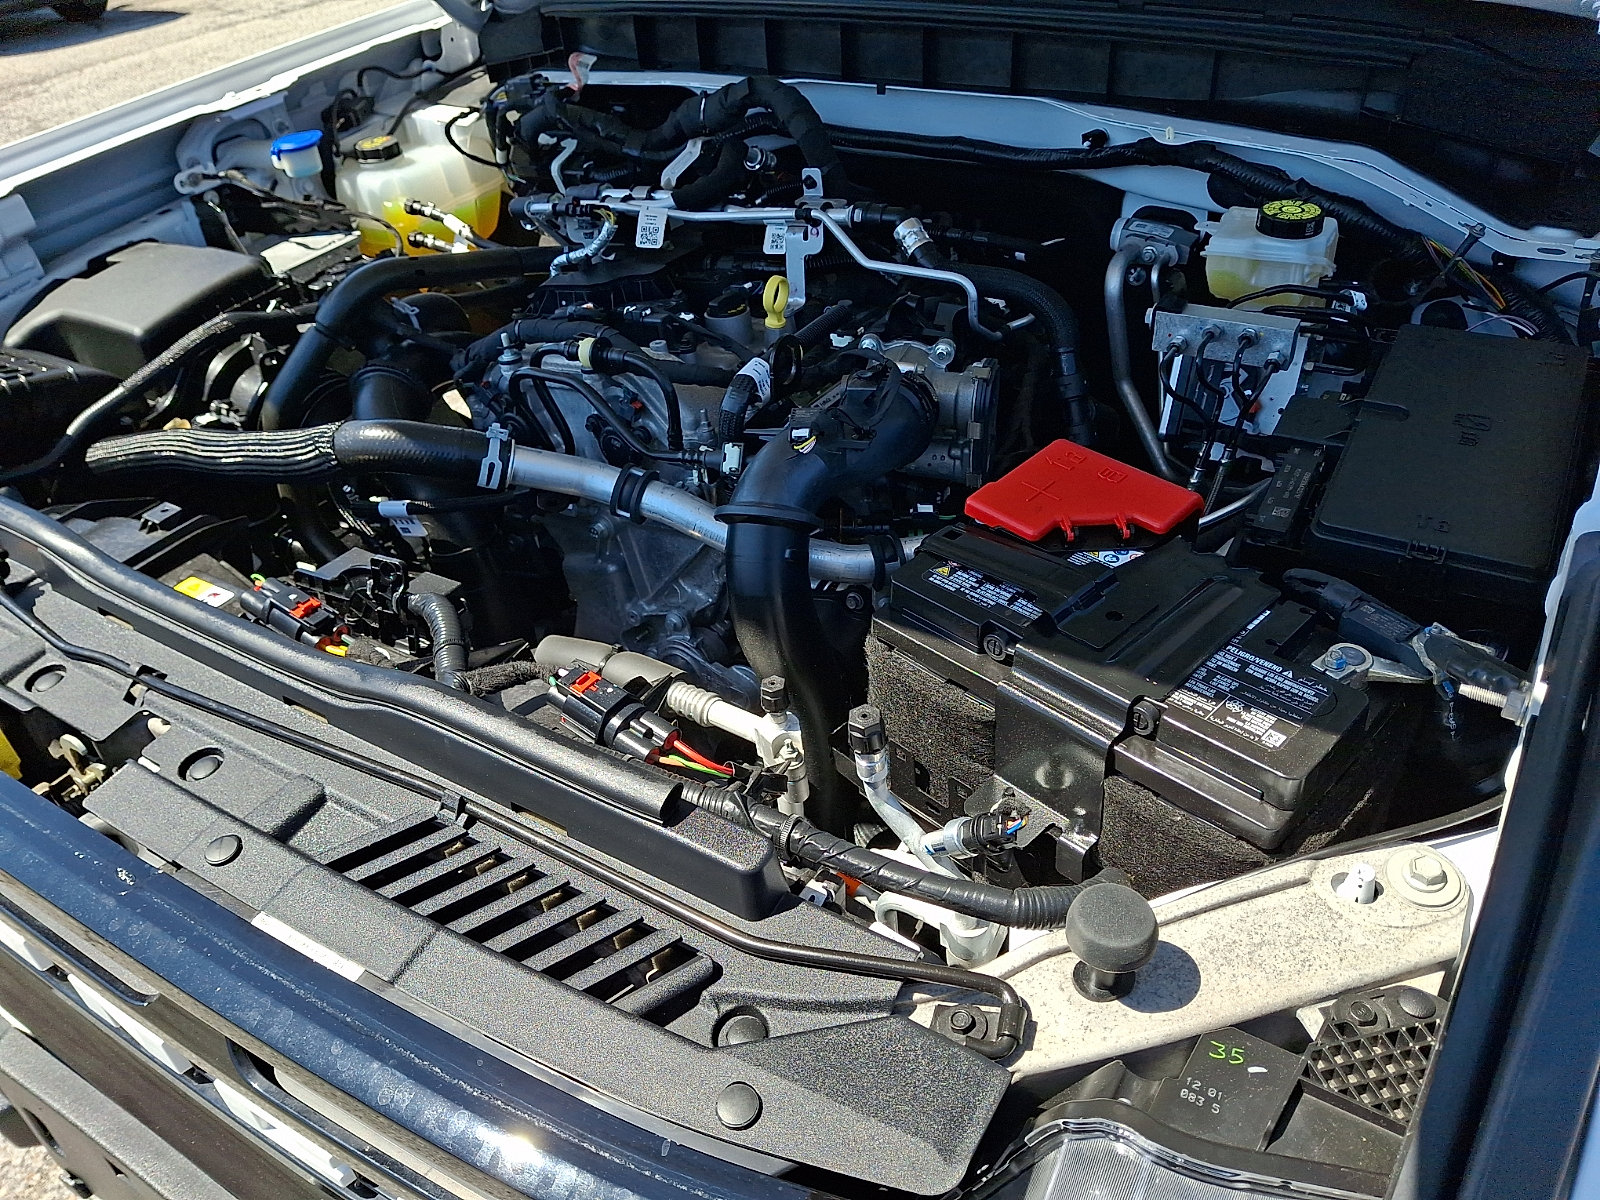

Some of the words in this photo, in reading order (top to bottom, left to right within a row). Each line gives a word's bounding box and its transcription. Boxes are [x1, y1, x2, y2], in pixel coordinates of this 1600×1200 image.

[1225, 644, 1283, 672] PELIGRO/VENENO
[1208, 1040, 1245, 1064] 35
[1180, 1088, 1205, 1107] 083
